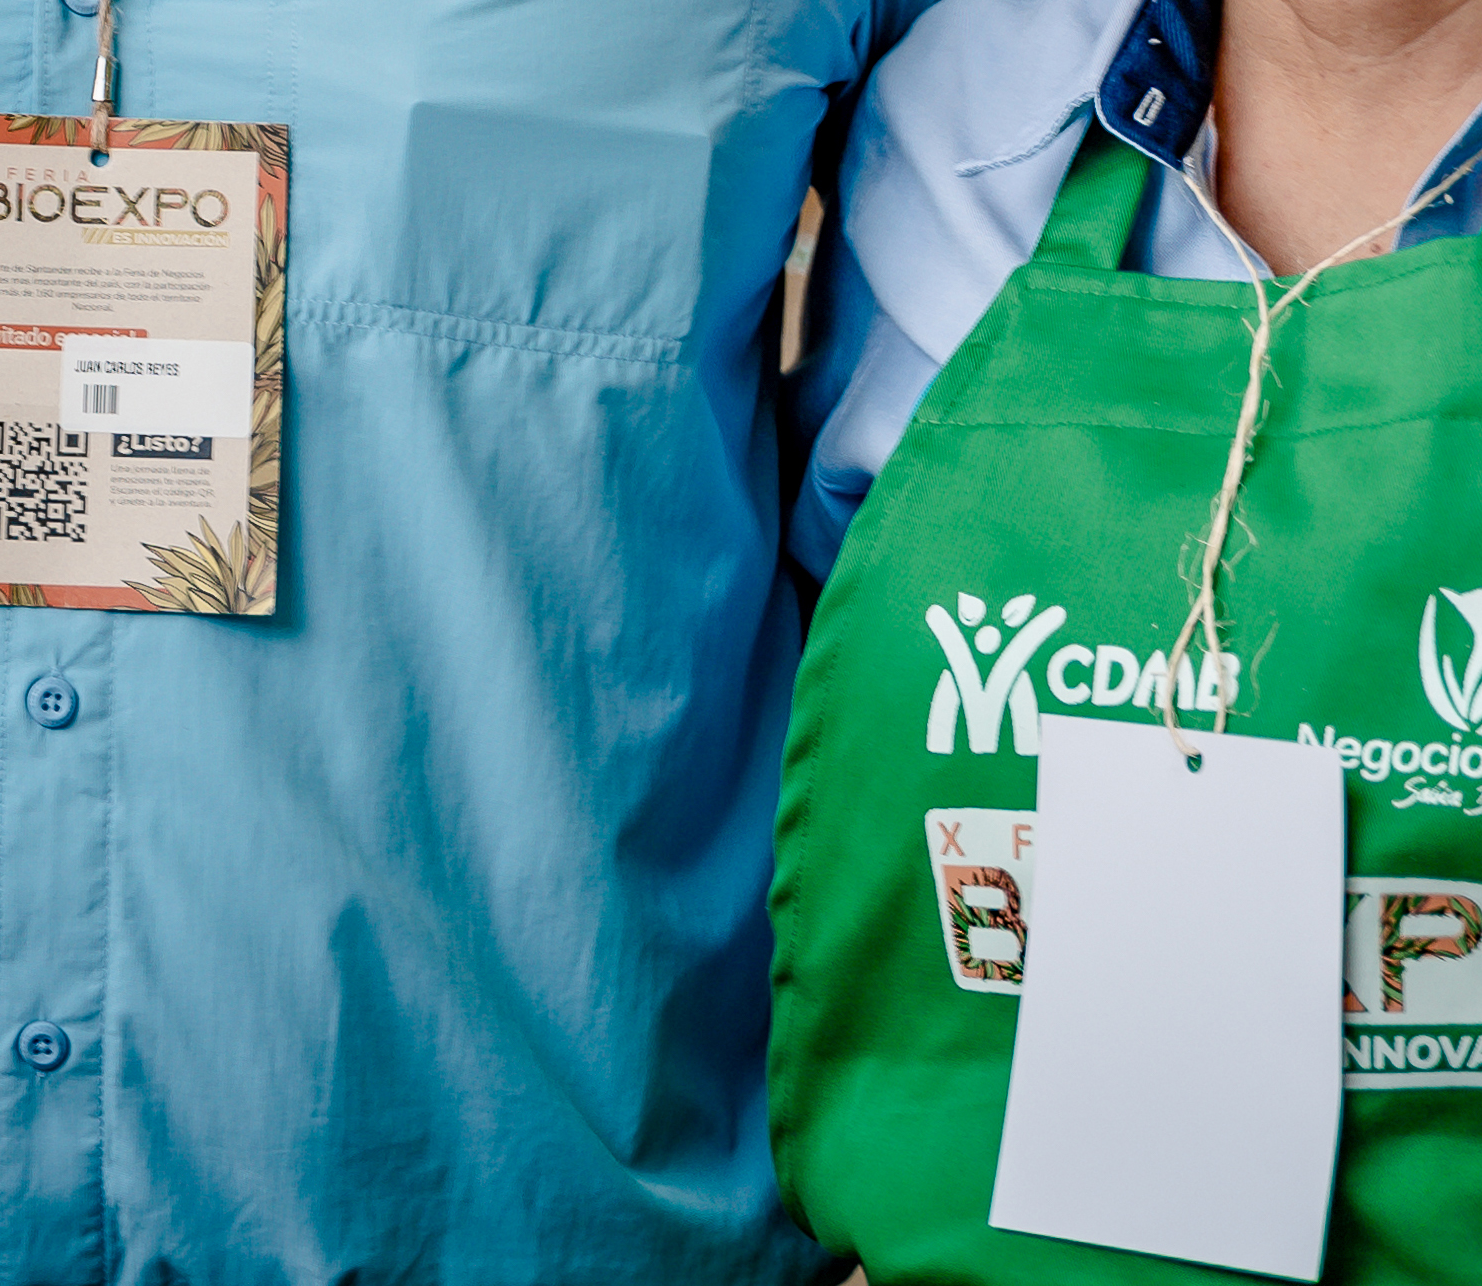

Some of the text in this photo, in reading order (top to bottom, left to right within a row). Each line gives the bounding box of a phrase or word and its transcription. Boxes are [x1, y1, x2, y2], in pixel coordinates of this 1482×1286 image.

[6, 167, 91, 183] FERIA
[112, 231, 229, 247] ES INNOVACIÓN
[74, 360, 180, 377] JUAN CARLOS REYES
[1046, 643, 1240, 712] CDMB
[937, 821, 966, 859] X
